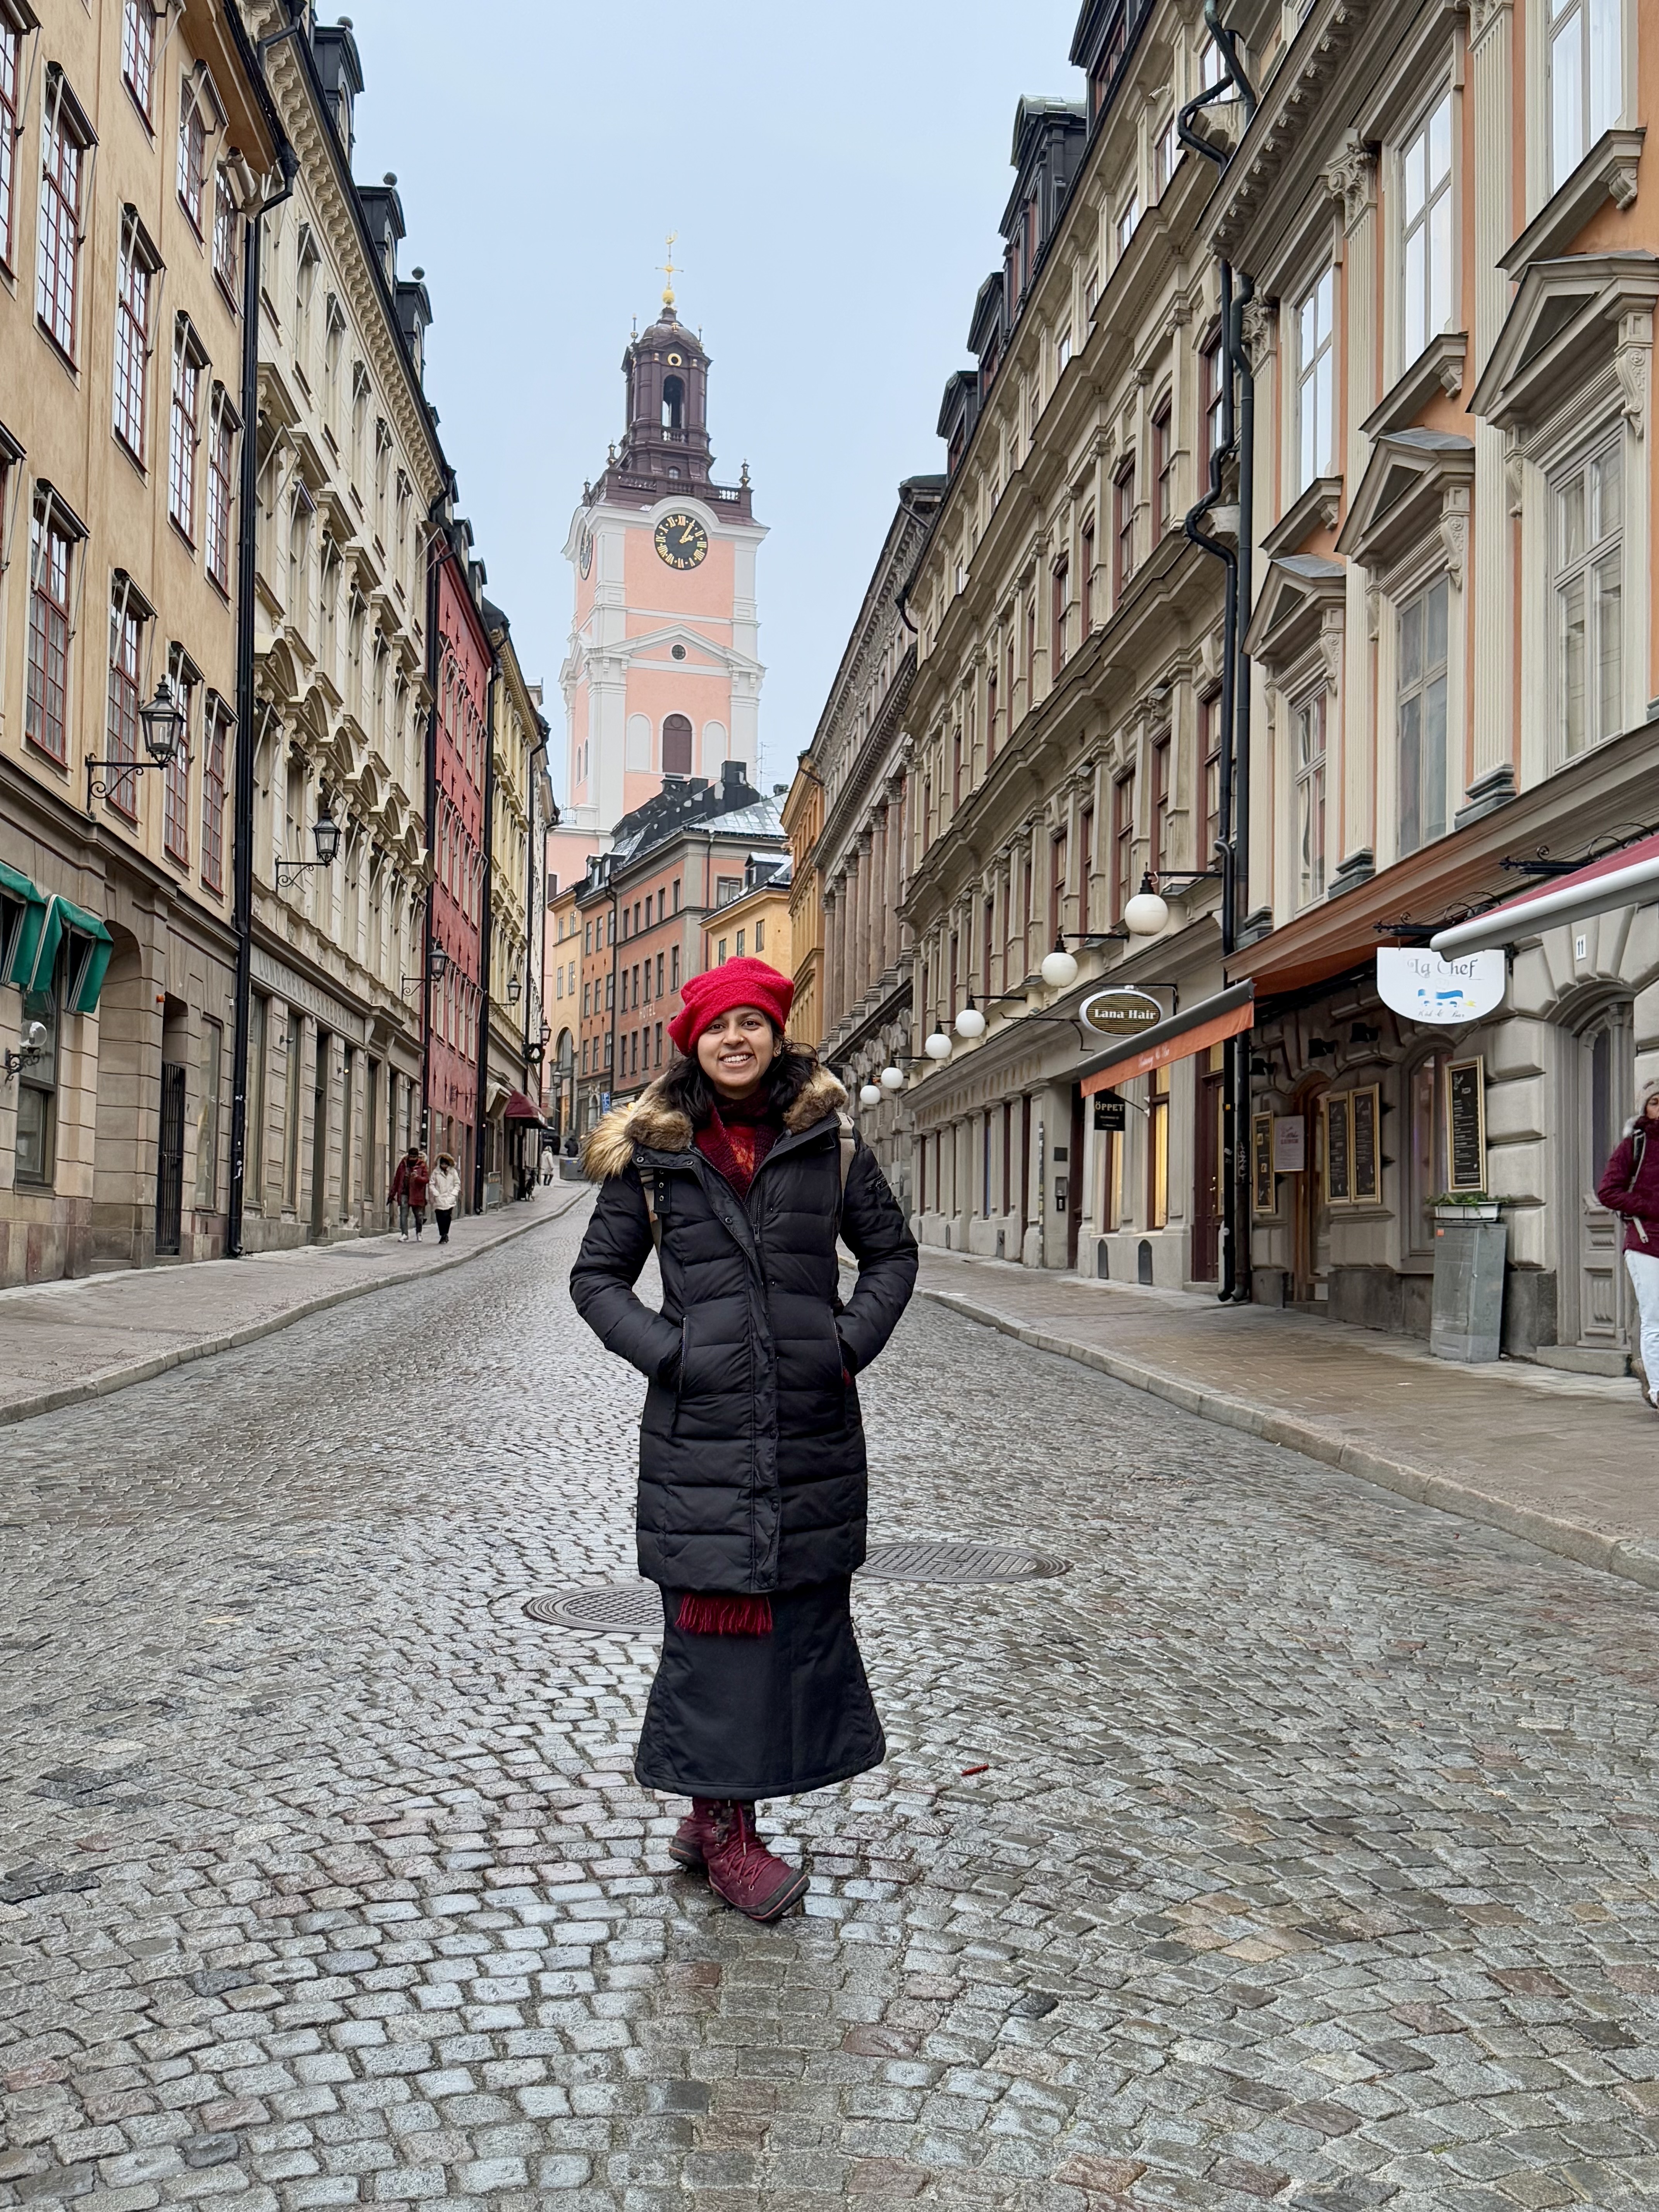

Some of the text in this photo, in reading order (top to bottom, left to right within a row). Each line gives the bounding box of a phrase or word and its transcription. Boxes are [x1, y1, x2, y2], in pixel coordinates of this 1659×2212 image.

[1578, 939, 1583, 955] 11
[1407, 958, 1479, 978] La Chef
[258, 952, 352, 1030] LUNDGRENS FISKREDSKAP
[639, 1003, 656, 1020] HOTEL
[1094, 1009, 1156, 1019] Lana Hair
[1095, 1101, 1124, 1111] ÖPPET
